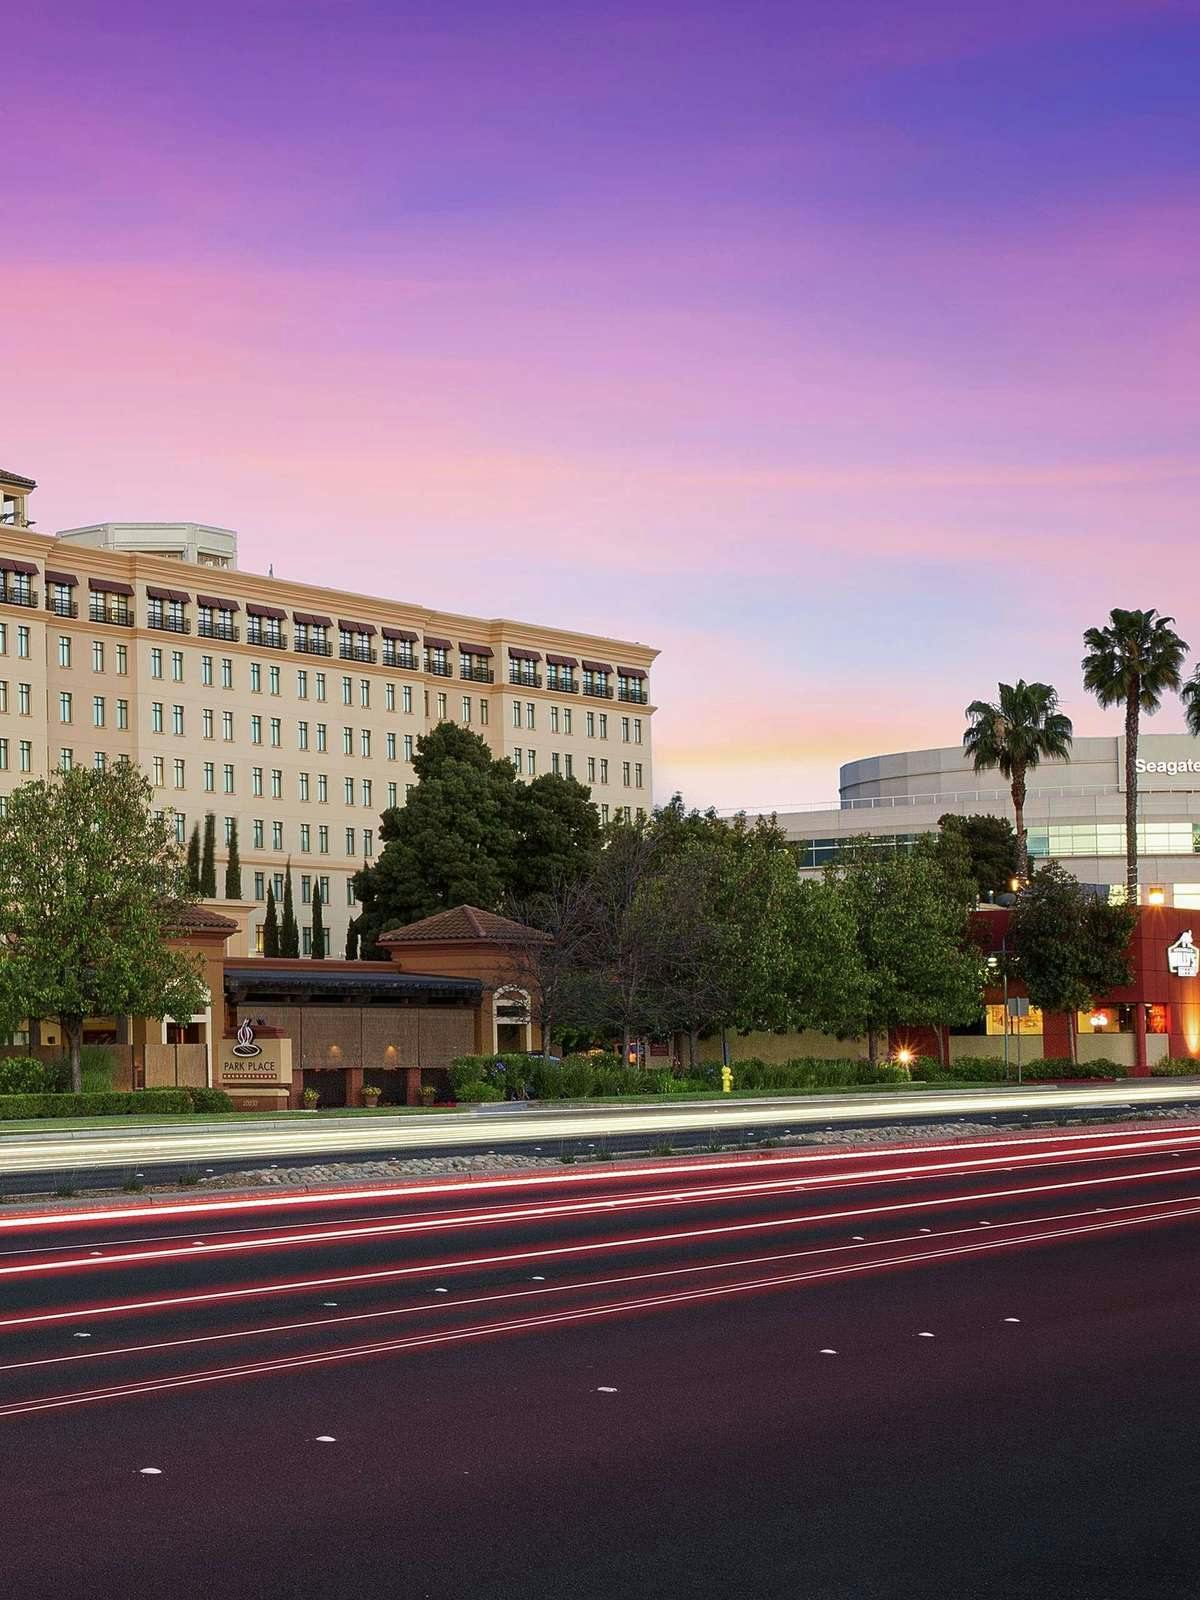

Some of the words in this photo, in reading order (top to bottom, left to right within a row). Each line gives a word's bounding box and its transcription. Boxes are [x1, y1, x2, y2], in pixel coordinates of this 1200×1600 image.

[1135, 758, 1200, 776] Seagate
[224, 1061, 245, 1071] PARK
[247, 1061, 275, 1071] PLACE
